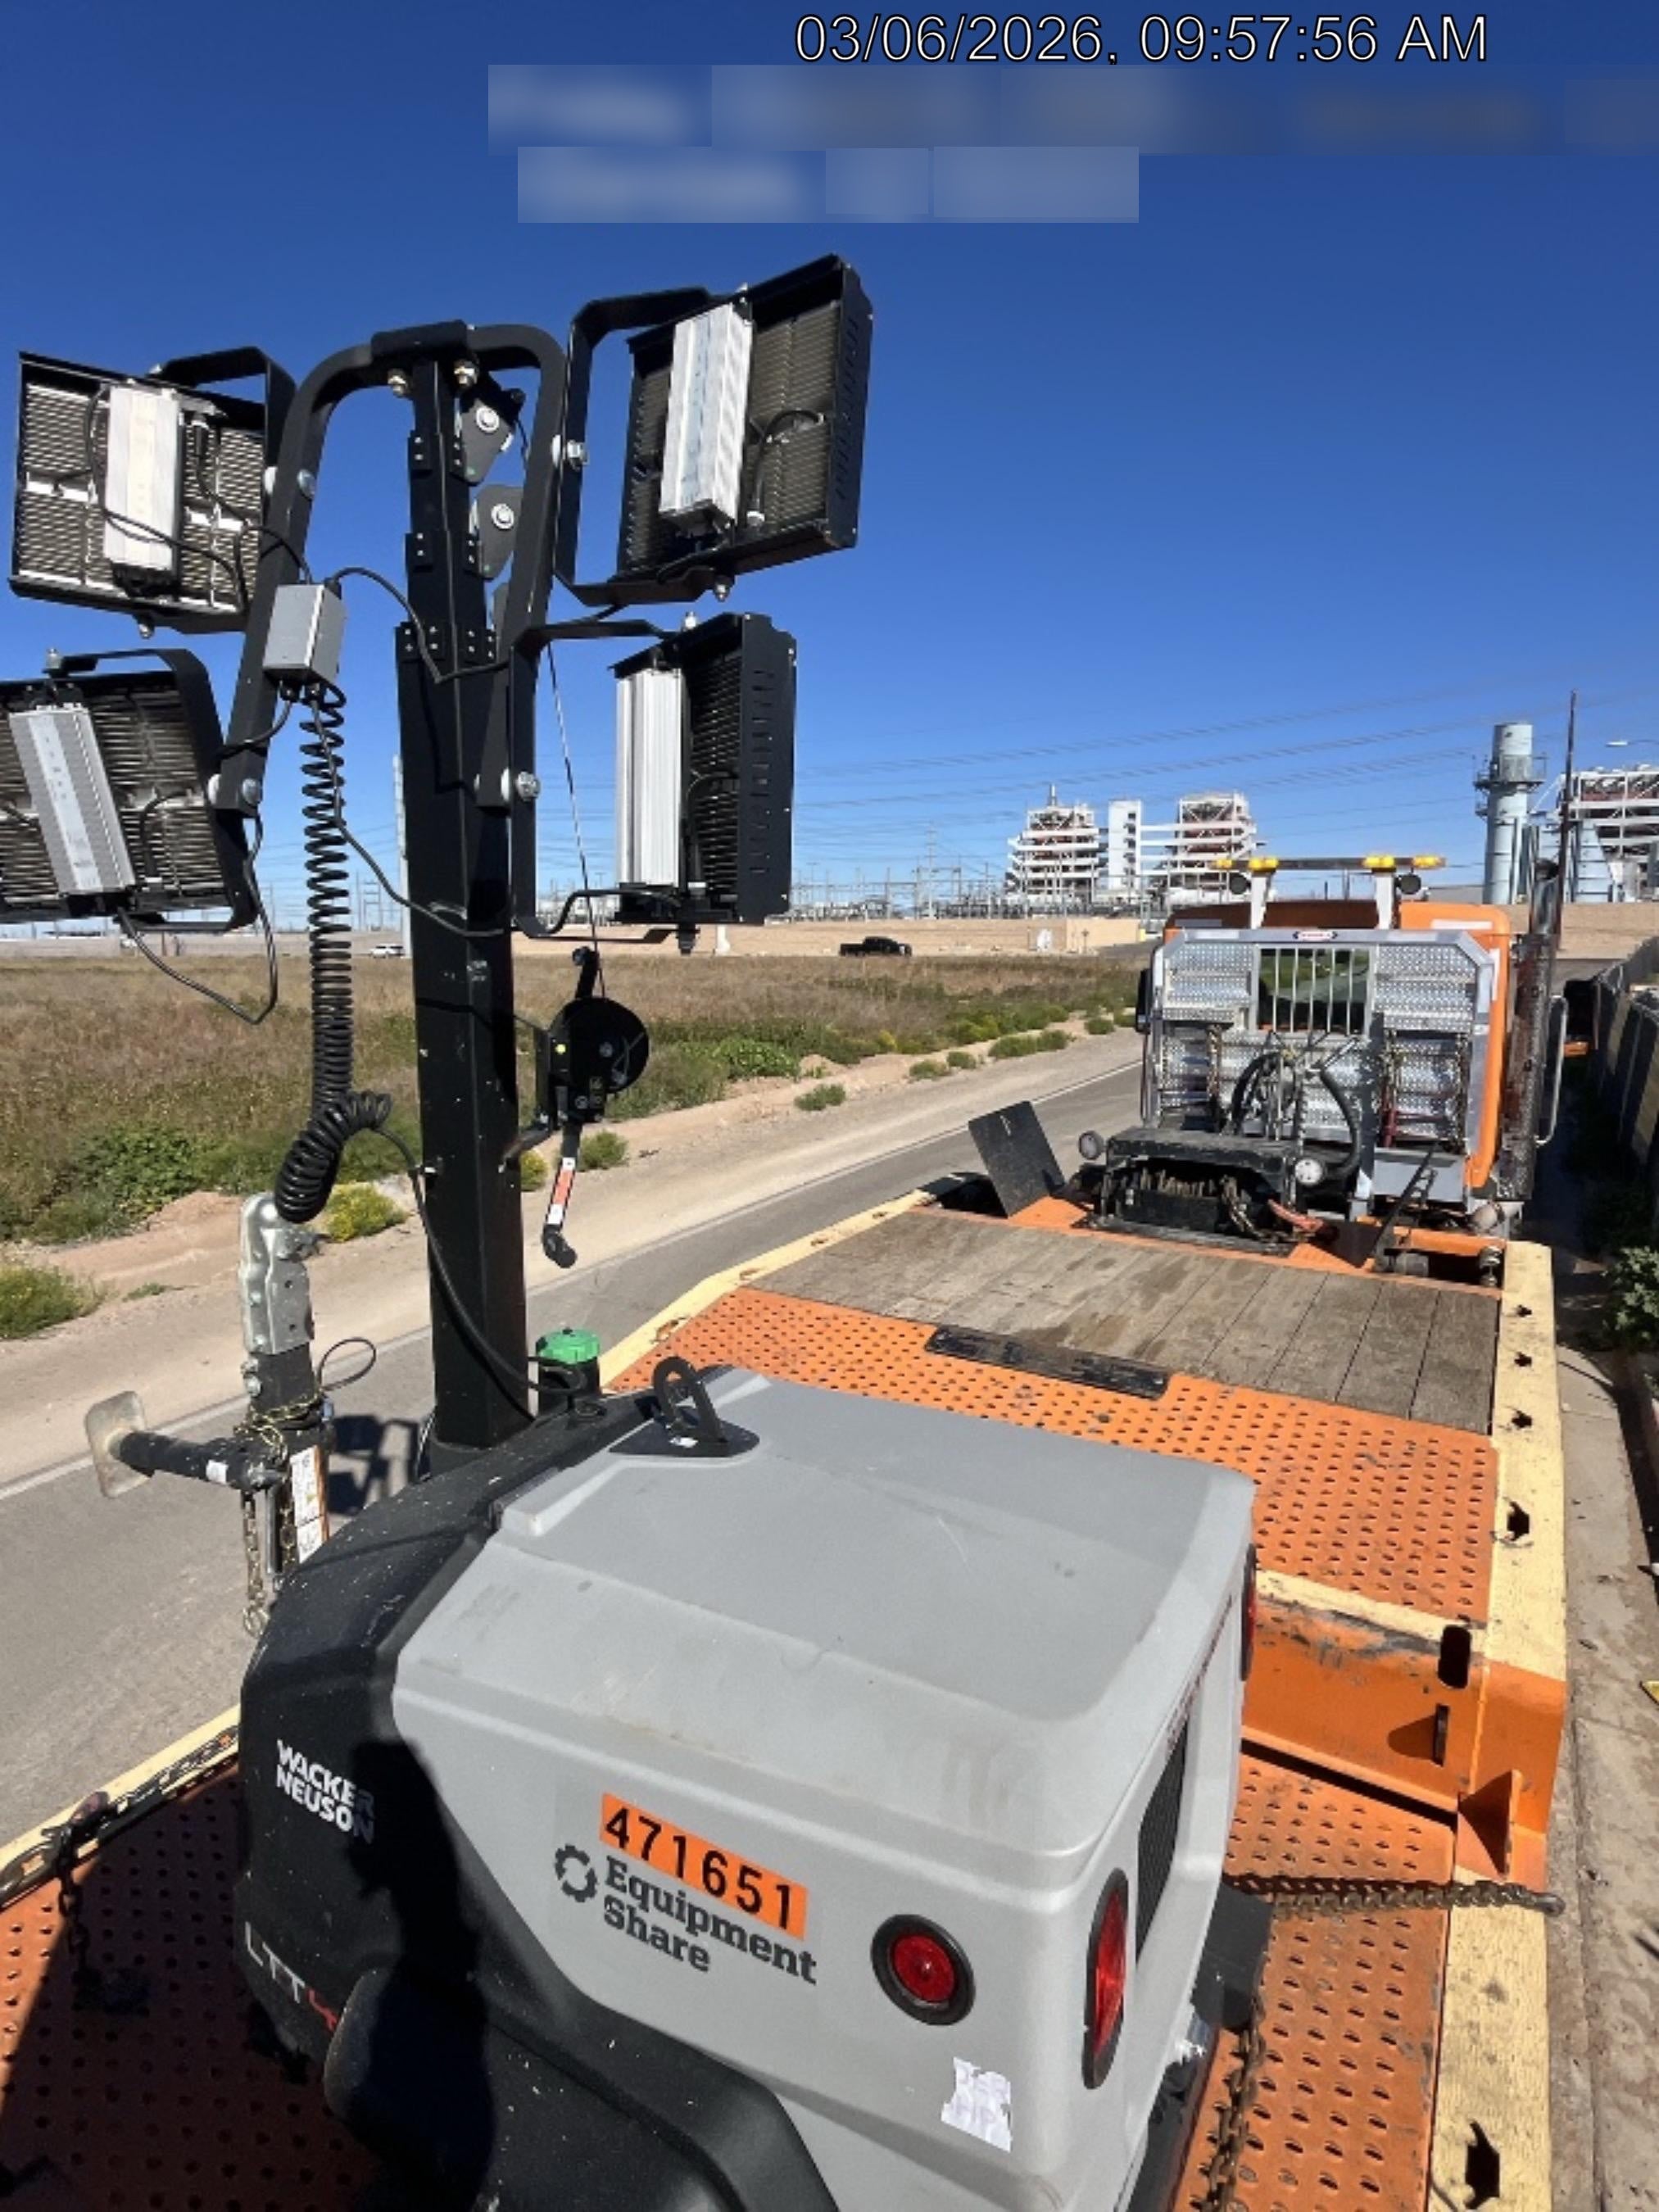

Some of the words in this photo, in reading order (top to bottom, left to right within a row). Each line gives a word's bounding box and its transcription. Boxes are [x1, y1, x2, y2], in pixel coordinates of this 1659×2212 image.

[277, 1738, 374, 1818] WACKER
[277, 1763, 374, 1845] NEUSON
[605, 1806, 792, 1929] 471651
[604, 1893, 710, 1973] Share
[605, 1855, 817, 1986] Equipment
